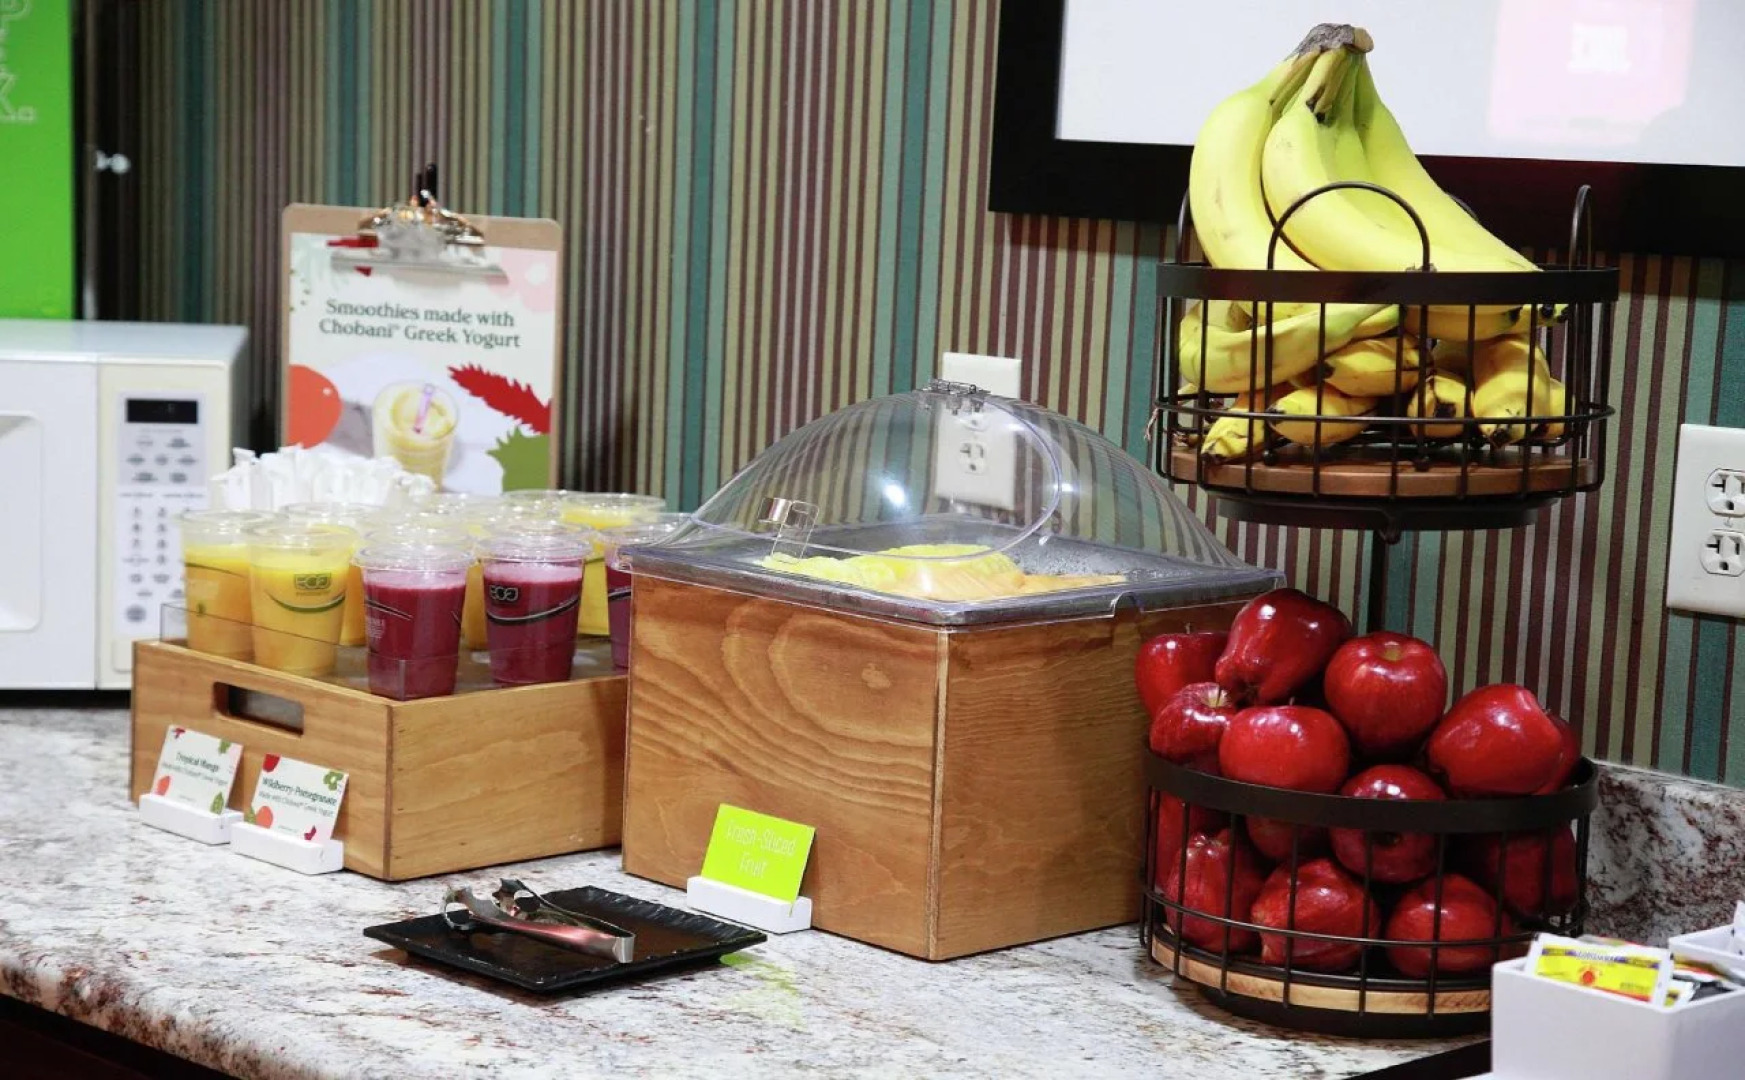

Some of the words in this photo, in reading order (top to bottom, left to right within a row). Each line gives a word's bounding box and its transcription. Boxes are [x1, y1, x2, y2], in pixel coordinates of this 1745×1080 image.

[325, 298, 420, 320] Smoothies
[423, 308, 472, 323] made
[476, 311, 515, 327] with
[404, 325, 457, 343] Greek
[462, 329, 521, 349] Yogurt
[262, 777, 293, 796] Wildberry
[295, 786, 338, 806] Pomegranate
